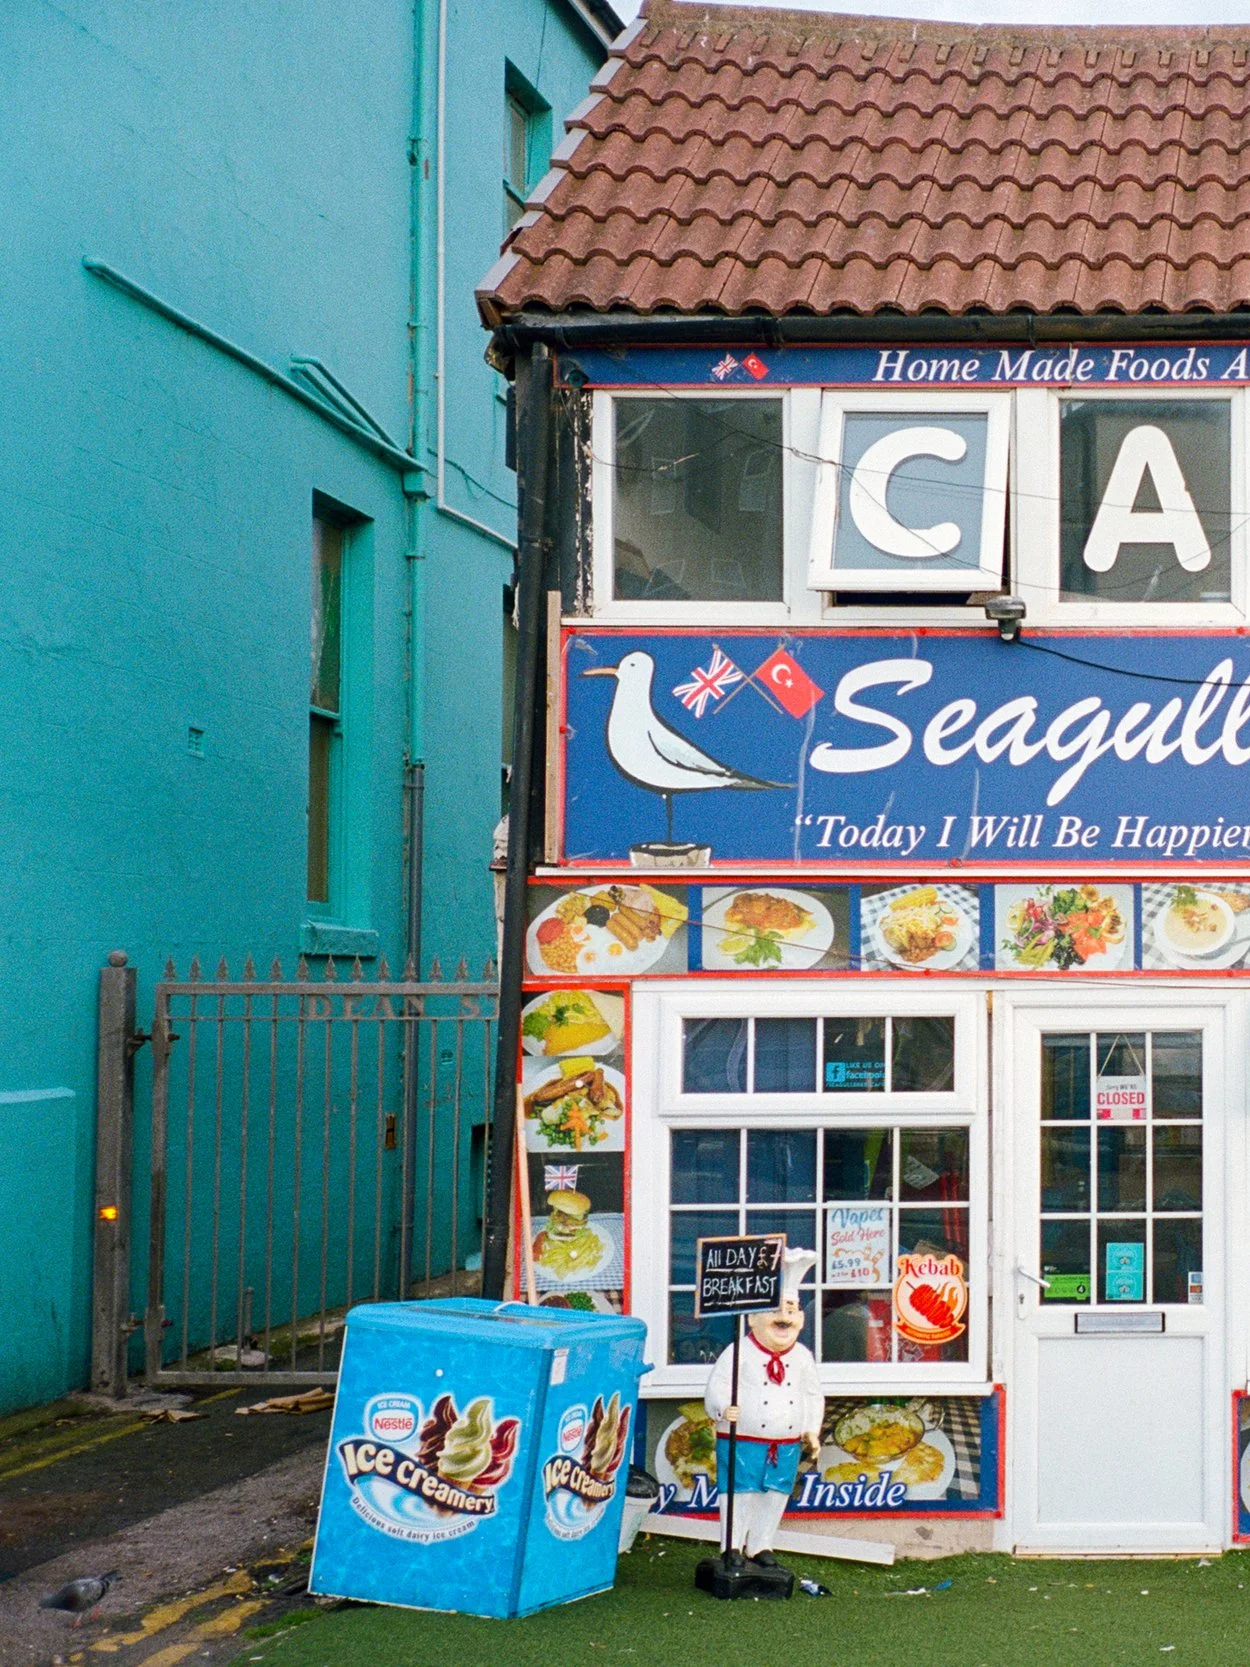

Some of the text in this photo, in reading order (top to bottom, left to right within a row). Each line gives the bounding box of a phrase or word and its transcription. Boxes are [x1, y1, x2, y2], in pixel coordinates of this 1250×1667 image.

[872, 349, 980, 381] Home
[991, 349, 1096, 381] Made
[1104, 348, 1211, 380] Foods
[937, 816, 957, 847] I
[969, 815, 1045, 847] Will
[1053, 816, 1100, 847] Be
[308, 994, 426, 1018] DEAN
[1097, 1092, 1145, 1105] CLOSED
[832, 1207, 884, 1229] Vapes
[831, 1227, 886, 1246] Sold Here
[726, 1246, 757, 1269] DAY
[832, 1258, 861, 1269] £5.99
[900, 1258, 961, 1278] Kebab
[851, 1267, 870, 1278] £10
[703, 1275, 778, 1298] BREAKFAST
[389, 1401, 411, 1409] CREAM
[344, 1442, 395, 1477] Ice
[545, 1459, 571, 1493] Ice
[798, 1471, 906, 1508] Inside
[352, 1496, 476, 1543] Delicious soft dairy ice cream
